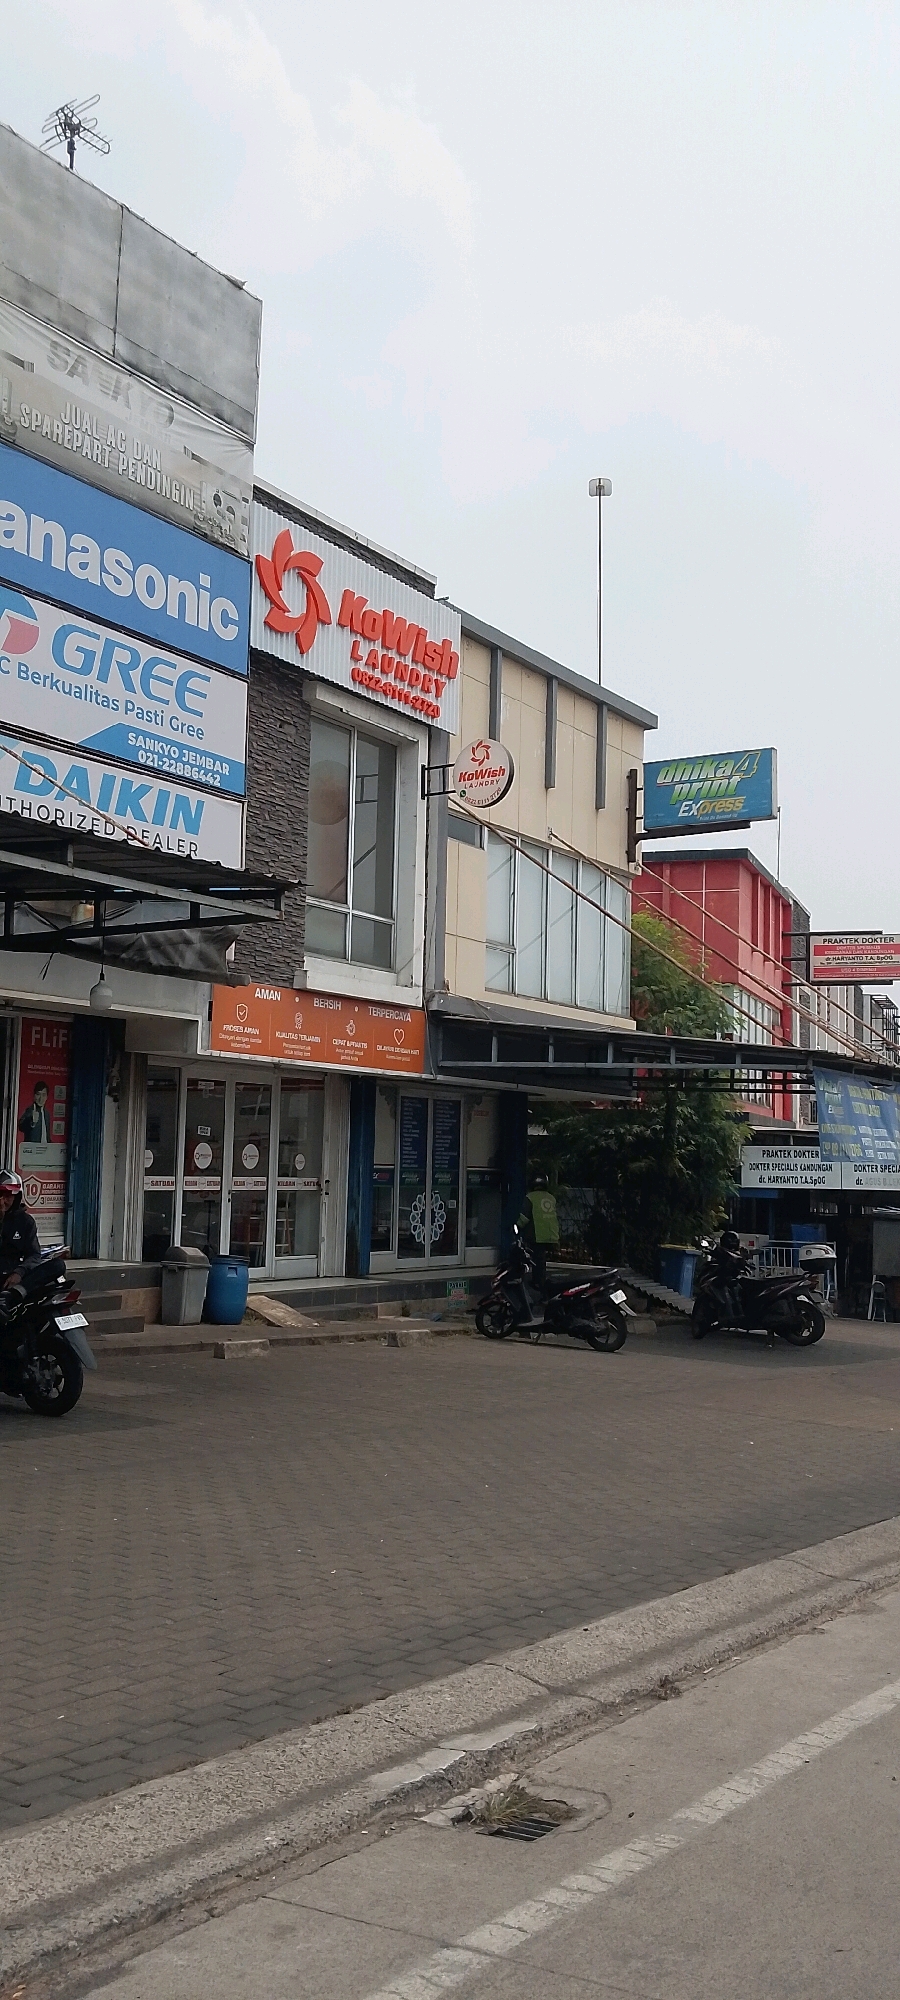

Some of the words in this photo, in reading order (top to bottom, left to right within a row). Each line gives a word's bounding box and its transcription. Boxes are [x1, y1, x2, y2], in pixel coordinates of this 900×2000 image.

[60, 402, 100, 439] JUAL
[107, 425, 126, 452] AC
[133, 438, 161, 471] DAN
[20, 403, 112, 468] SPAREPART
[118, 452, 194, 511] PENDINGIN
[51, 624, 211, 718] GREE
[351, 640, 446, 698] LAUNDRY
[17, 662, 119, 711] Berkualitas
[124, 699, 164, 727] Pasti
[169, 716, 205, 740] Gree
[128, 732, 179, 758] SANKYO
[182, 750, 229, 775] JEMBAR
[138, 750, 220, 786] 021-22886442
[14, 751, 205, 835] DAIKIN
[465, 779, 500, 790] LAUNDRY
[670, 776, 741, 805] print
[0, 795, 116, 836] THORIZED
[127, 825, 198, 856] DEALER
[255, 988, 281, 1001] AMAN
[314, 998, 341, 1010] BERSIH
[368, 1006, 411, 1022] TERPERCAYA
[276, 1031, 298, 1040] KUALITAS
[749, 1163, 770, 1172] DOKTER
[771, 1163, 798, 1172] SPECIALIS
[800, 1163, 833, 1172] KANDUNGAN
[762, 1150, 792, 1158] PRAKTEK
[794, 1150, 819, 1159] DOKTER
[853, 1164, 878, 1173] DOKTER
[26, 1183, 38, 1196] 10
[768, 1176, 798, 1184] HARYANTO
[856, 1176, 864, 1185] dr.
[865, 1177, 881, 1186] AGUS
